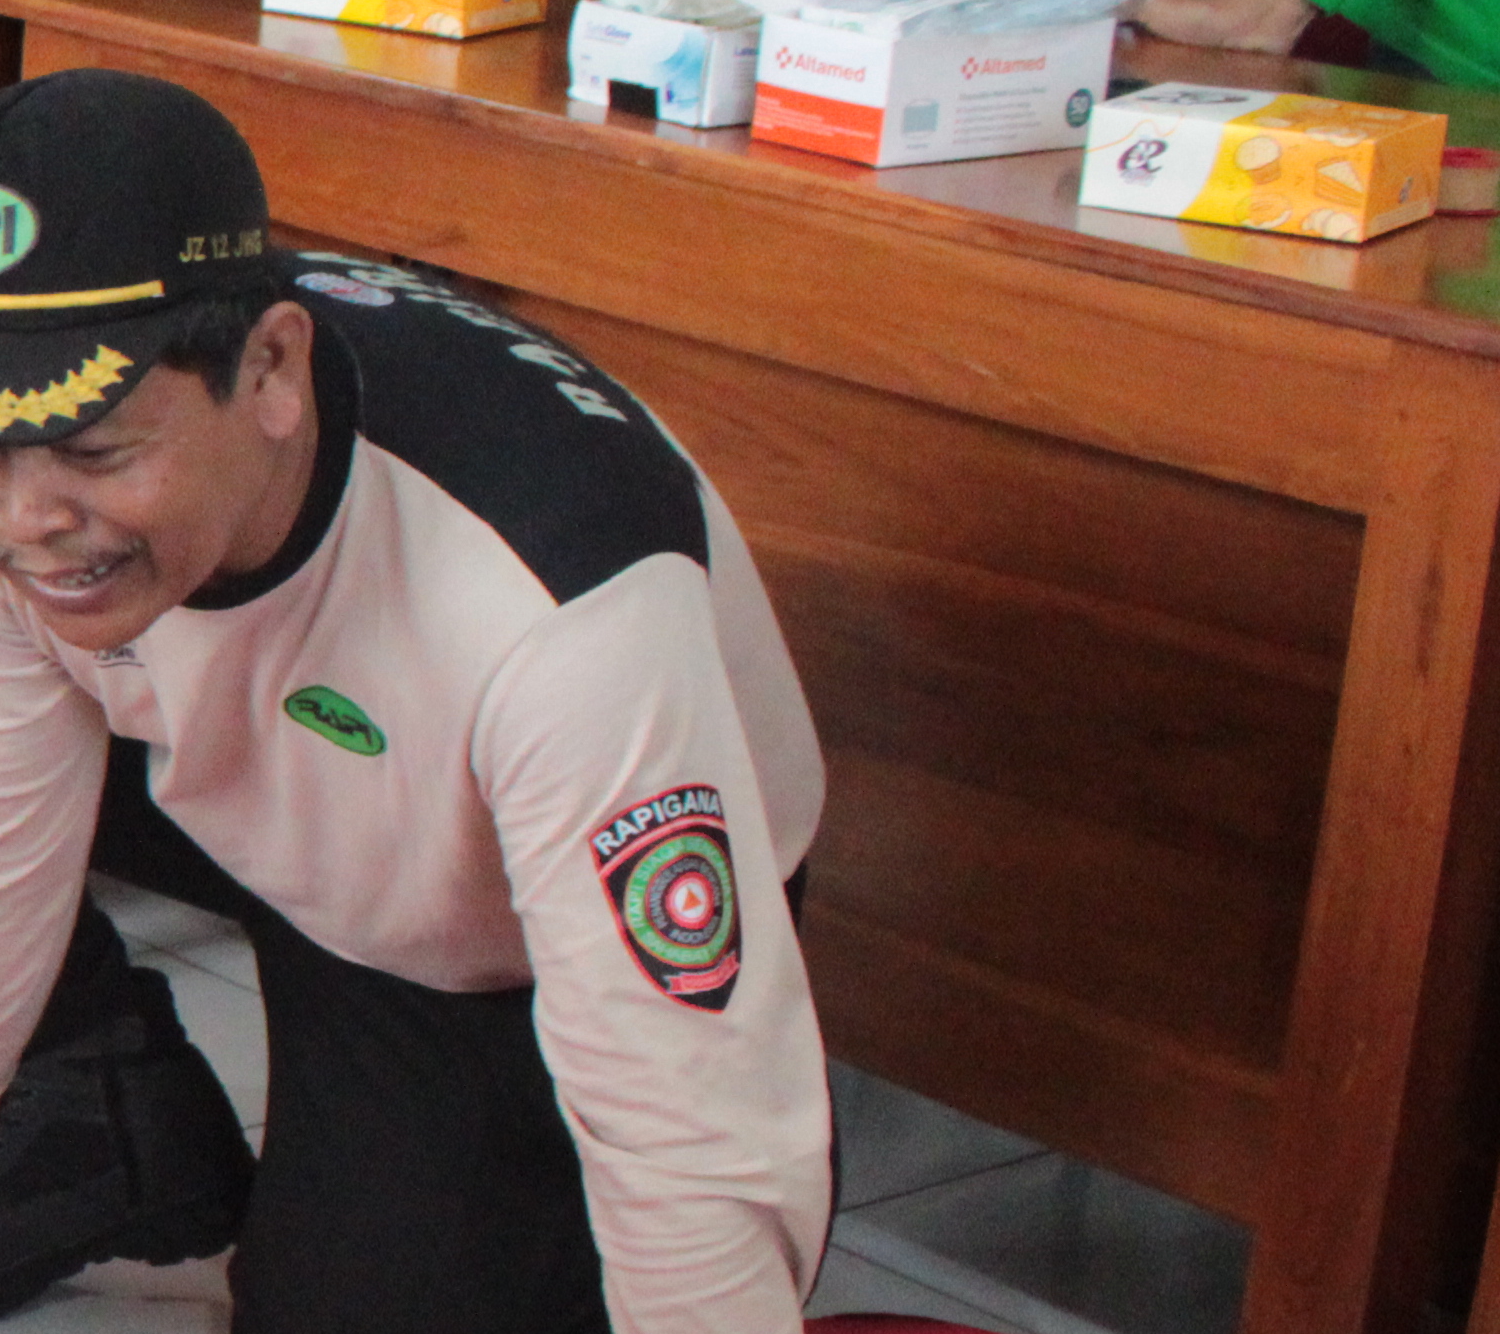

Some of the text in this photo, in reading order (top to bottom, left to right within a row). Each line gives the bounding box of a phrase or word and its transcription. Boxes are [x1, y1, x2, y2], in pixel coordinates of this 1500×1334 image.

[794, 53, 867, 83] Altamed
[979, 55, 1047, 75] Altamed
[592, 789, 722, 856] RAPIGANA
